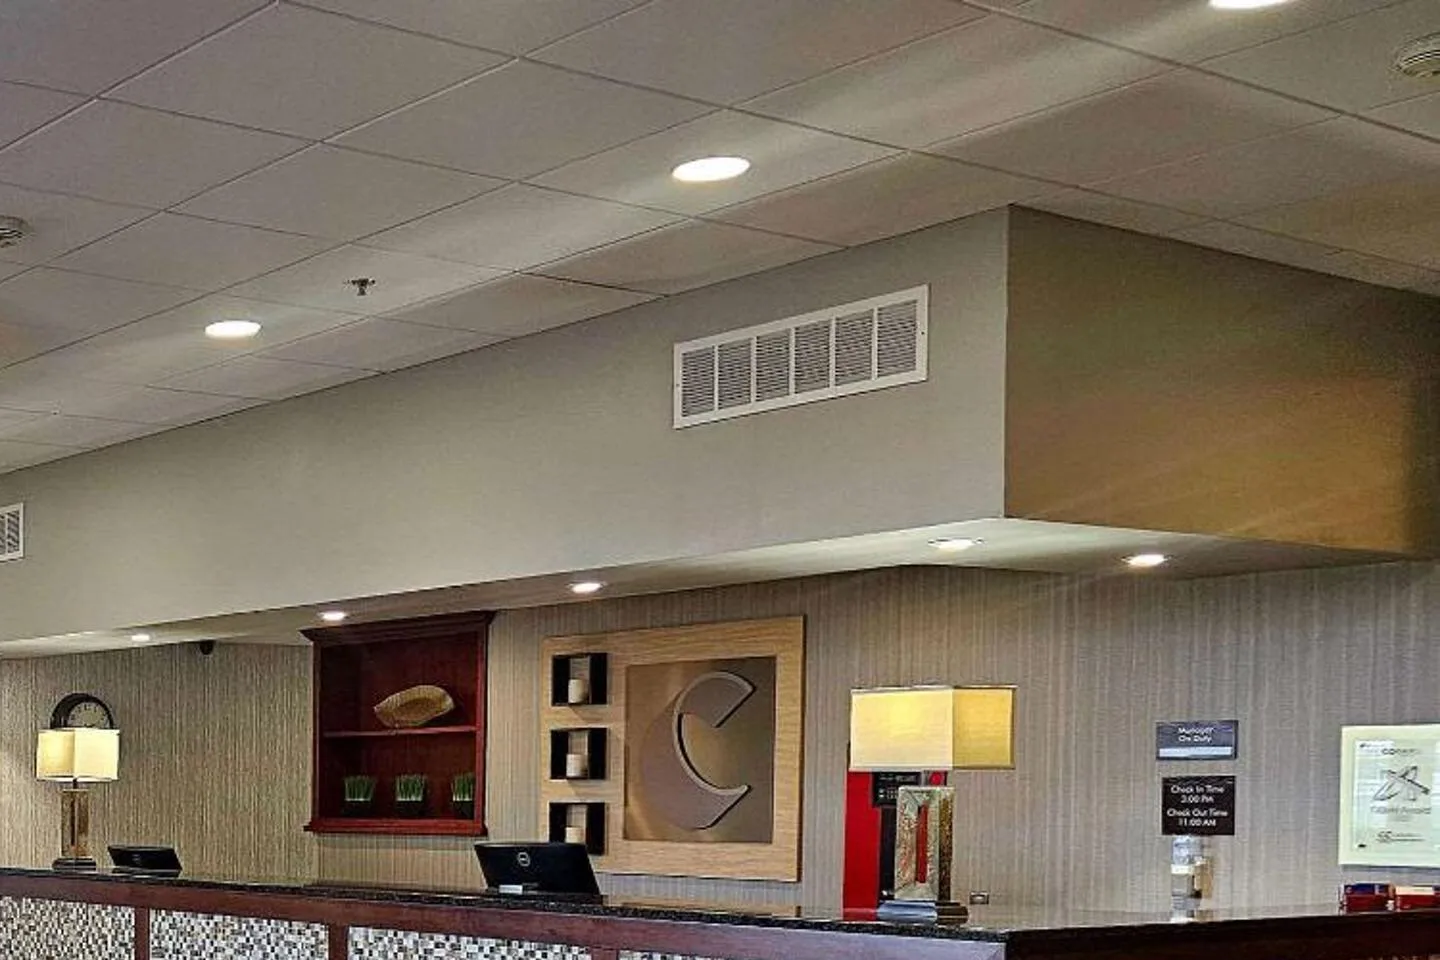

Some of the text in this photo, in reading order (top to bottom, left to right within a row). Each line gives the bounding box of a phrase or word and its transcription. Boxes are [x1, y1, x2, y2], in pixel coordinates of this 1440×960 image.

[1193, 734, 1212, 743] Duty
[1170, 784, 1225, 794] Check In Time
[1201, 794, 1214, 803] PM
[1166, 807, 1228, 817] Check Out Time
[1178, 817, 1216, 827] 11:00 AM
